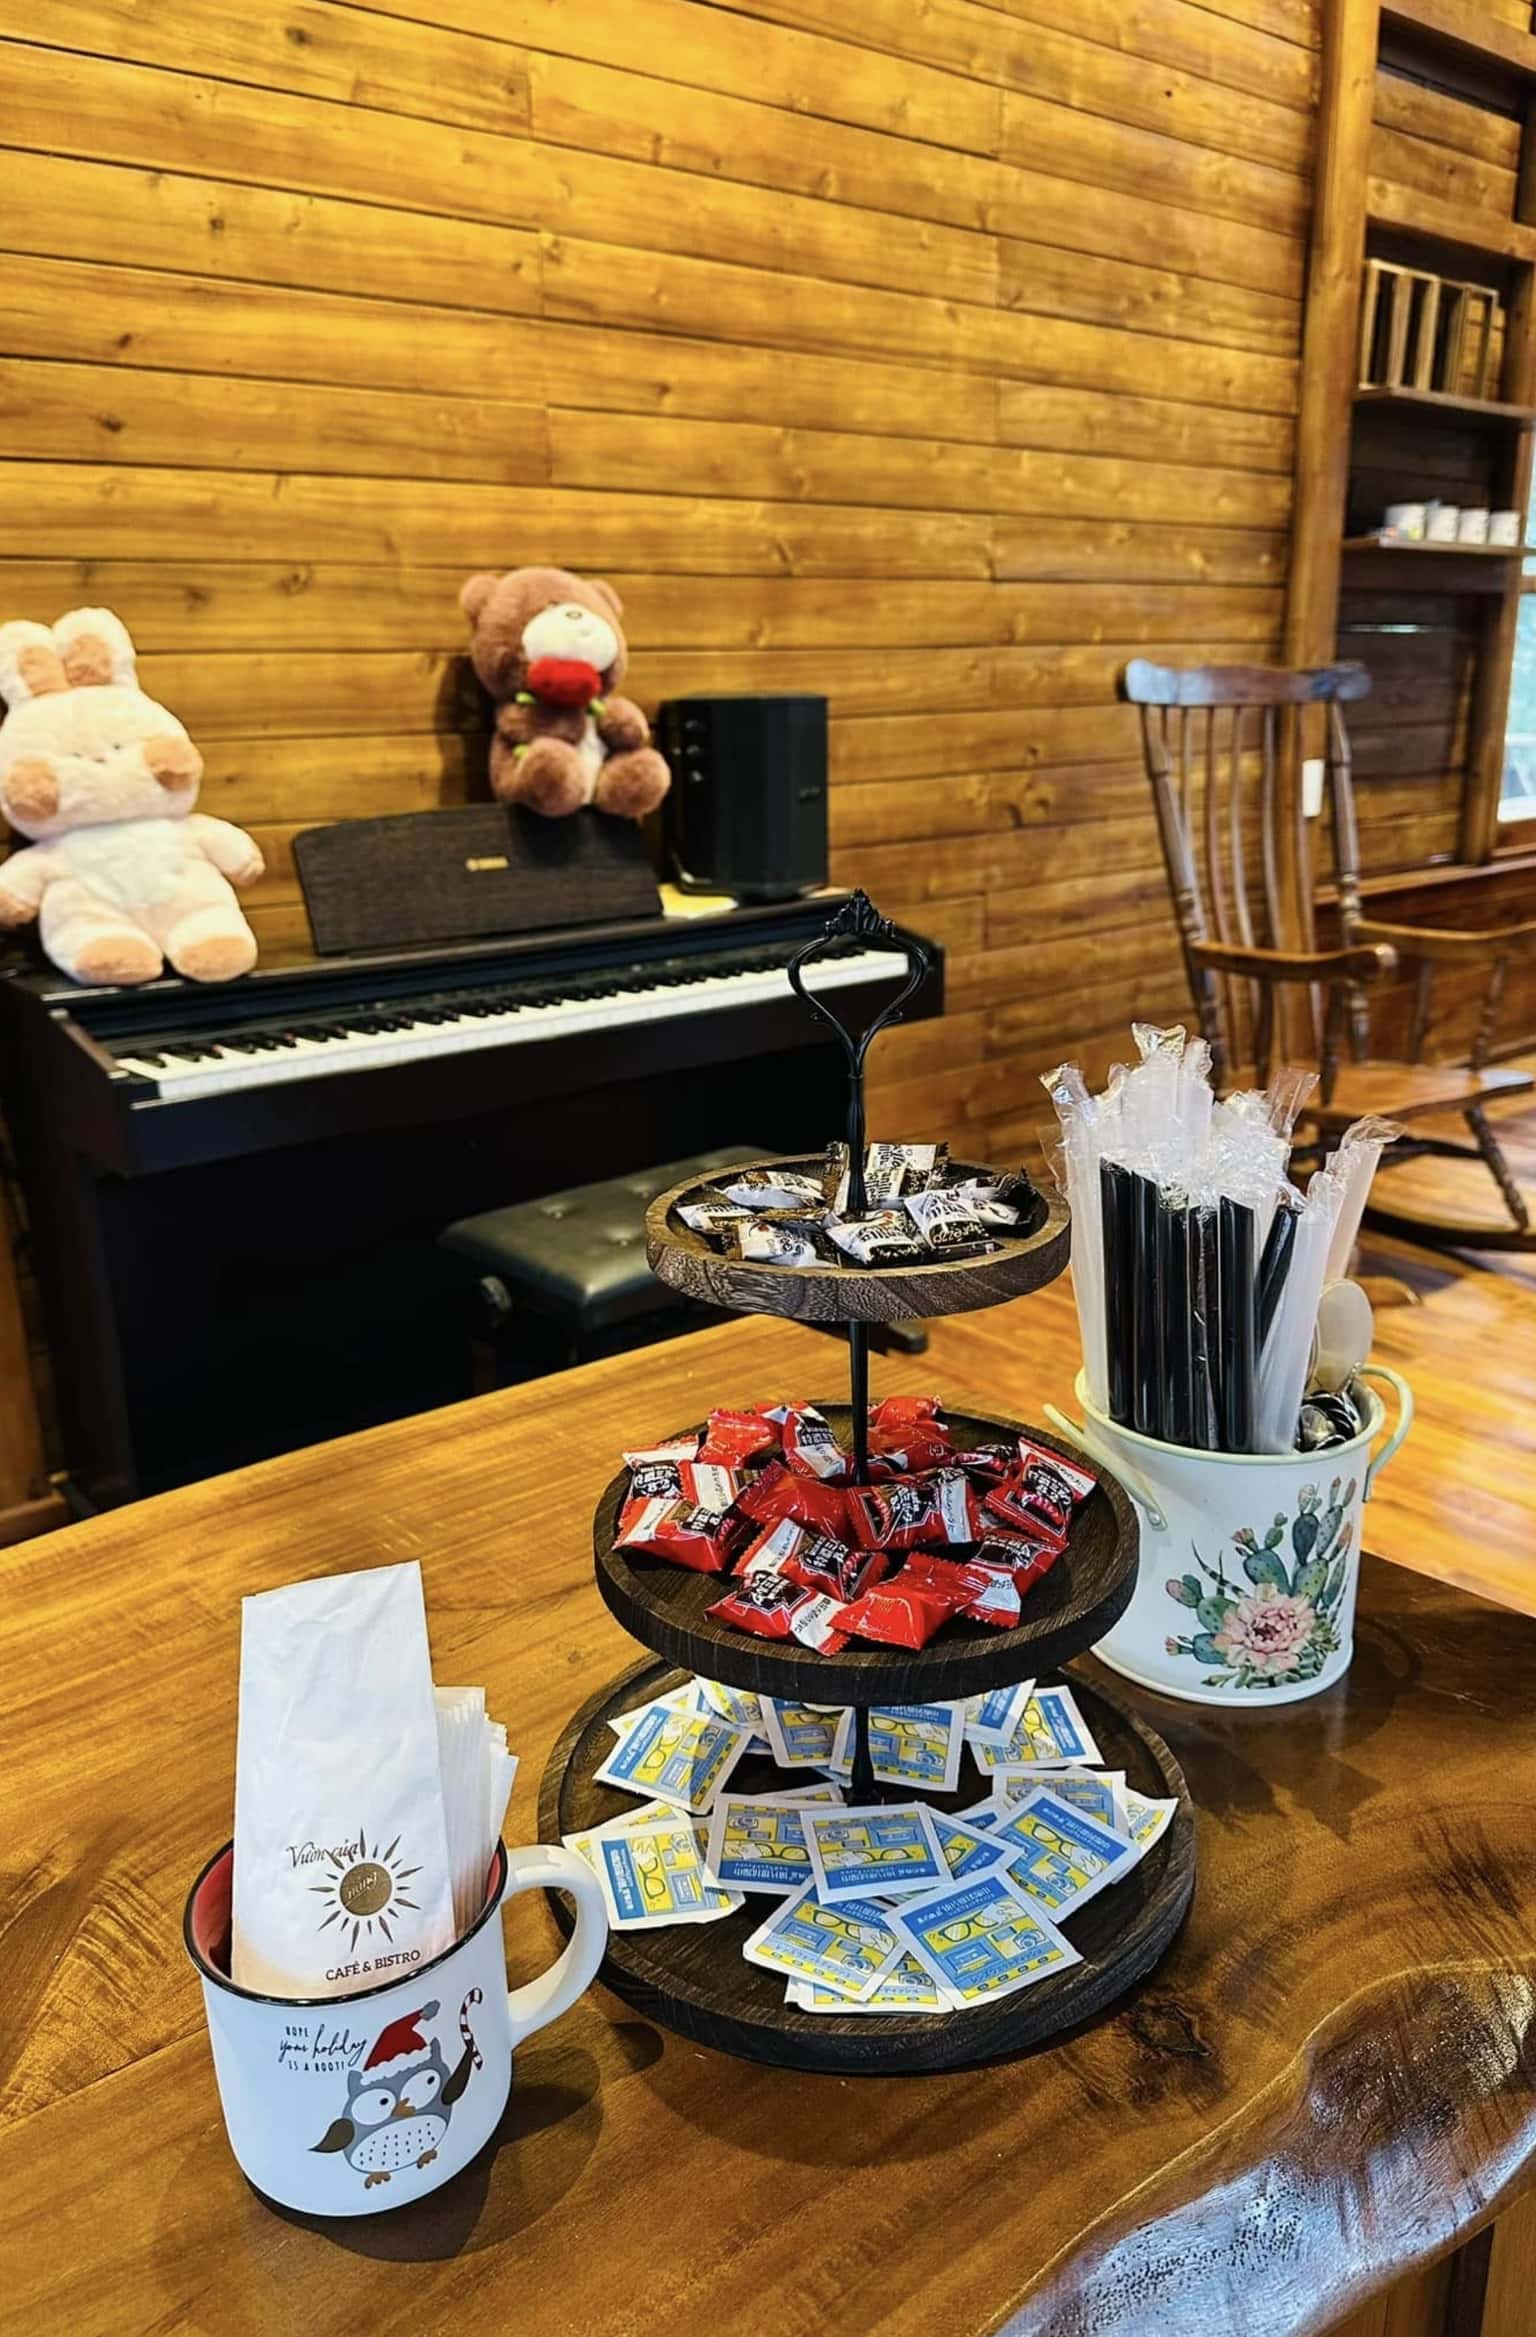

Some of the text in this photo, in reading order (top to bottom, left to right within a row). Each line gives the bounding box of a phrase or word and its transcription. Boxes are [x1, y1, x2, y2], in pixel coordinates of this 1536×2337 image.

[362, 1961, 372, 1973] &
[374, 1950, 421, 1970] BISTRO
[312, 2023, 367, 2067] holiday
